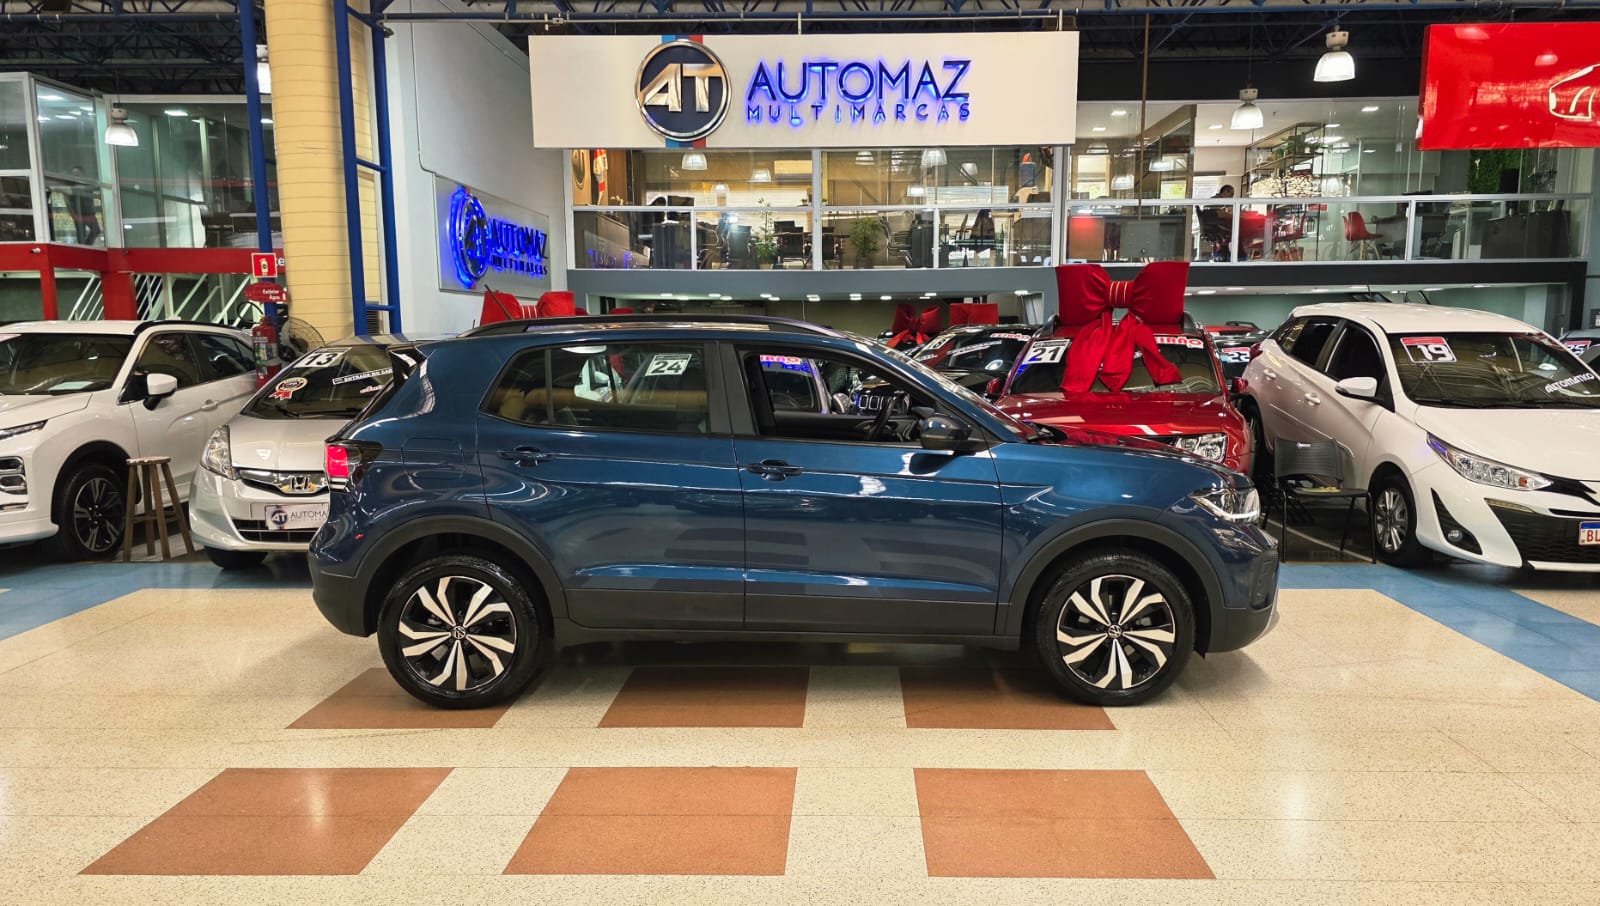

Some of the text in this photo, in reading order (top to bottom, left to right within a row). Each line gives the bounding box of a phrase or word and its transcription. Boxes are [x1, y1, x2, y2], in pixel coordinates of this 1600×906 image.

[747, 60, 971, 101] AUTOMAZ
[747, 102, 971, 122] MULTIMARCAS
[305, 352, 336, 366] 13
[1030, 347, 1060, 362] 21
[1416, 344, 1454, 362] 19
[651, 360, 683, 374] 24
[290, 510, 328, 519] AUTOMA
